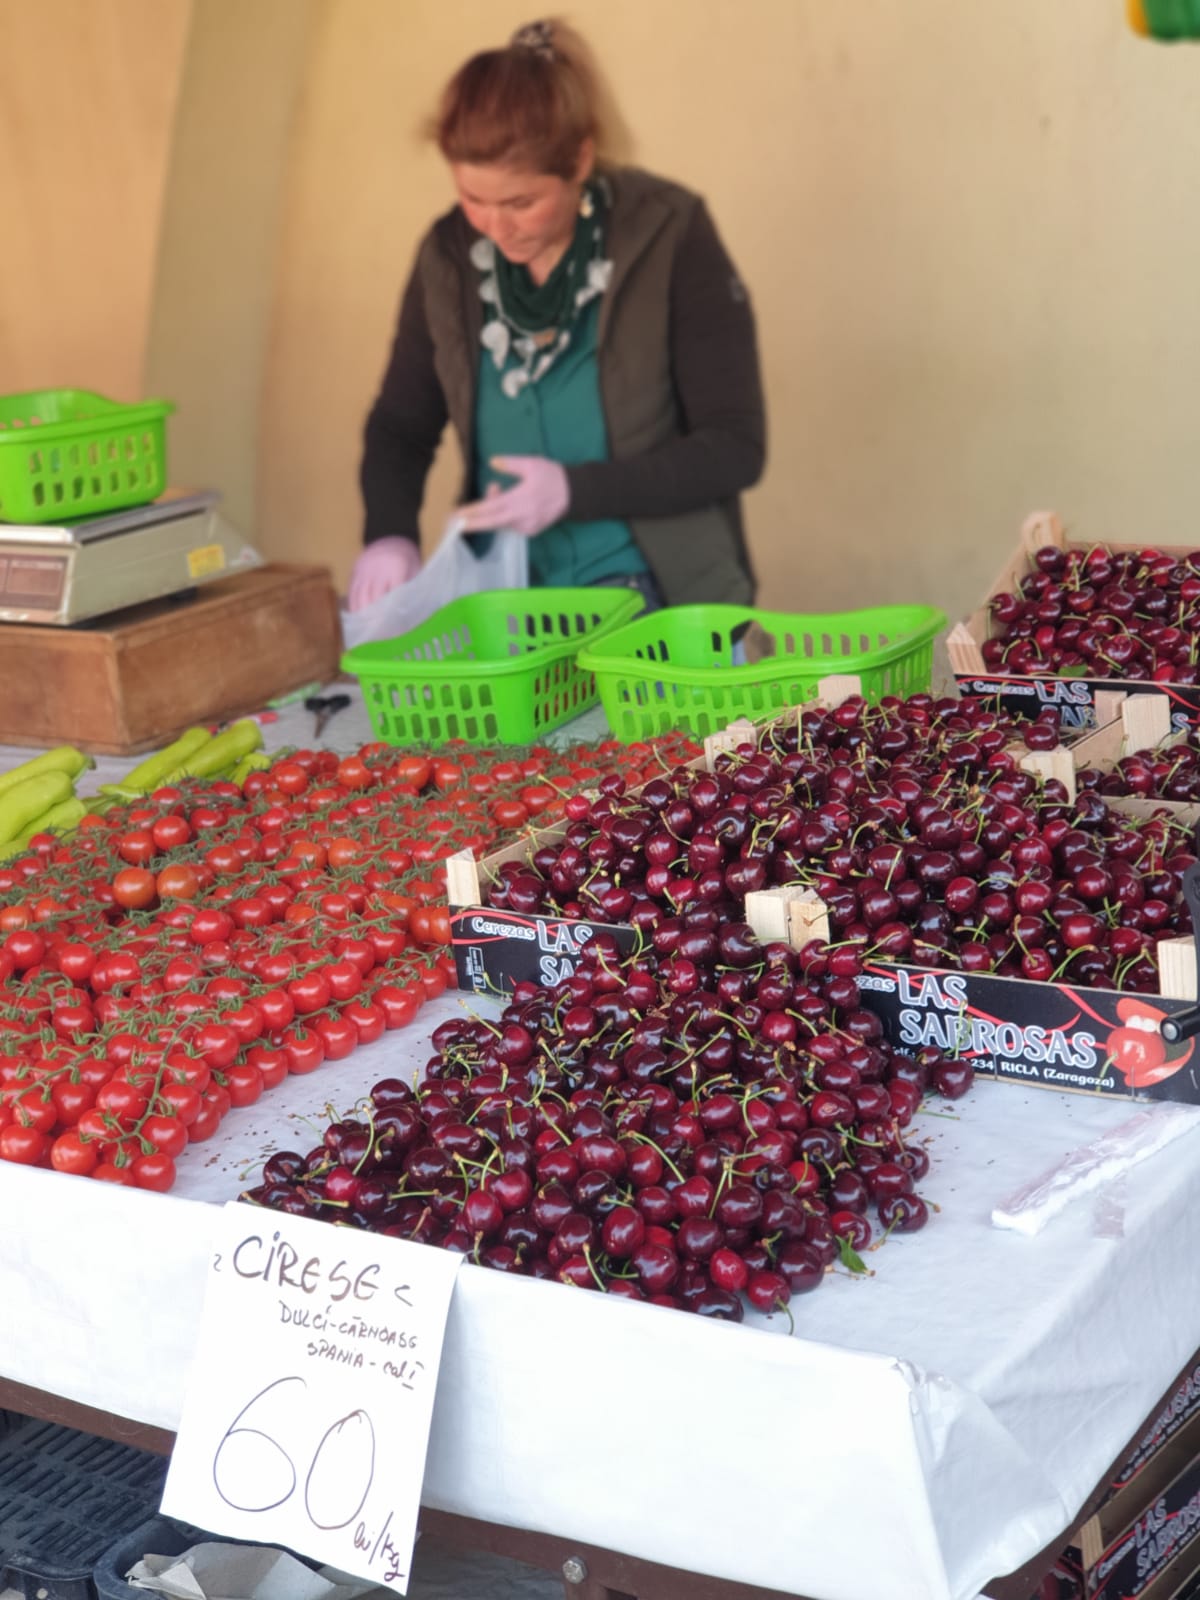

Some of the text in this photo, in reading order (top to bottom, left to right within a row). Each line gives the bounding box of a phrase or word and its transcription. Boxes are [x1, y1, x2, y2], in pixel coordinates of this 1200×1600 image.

[1033, 681, 1092, 705] LAS
[471, 917, 593, 955] Cerezas LAS
[897, 969, 968, 1011] LAS
[899, 1009, 1097, 1069] SABROSAS
[1000, 1061, 1039, 1076] RICLA
[1043, 1067, 1115, 1088] (Zaragoza)
[213, 1376, 375, 1530] 60
